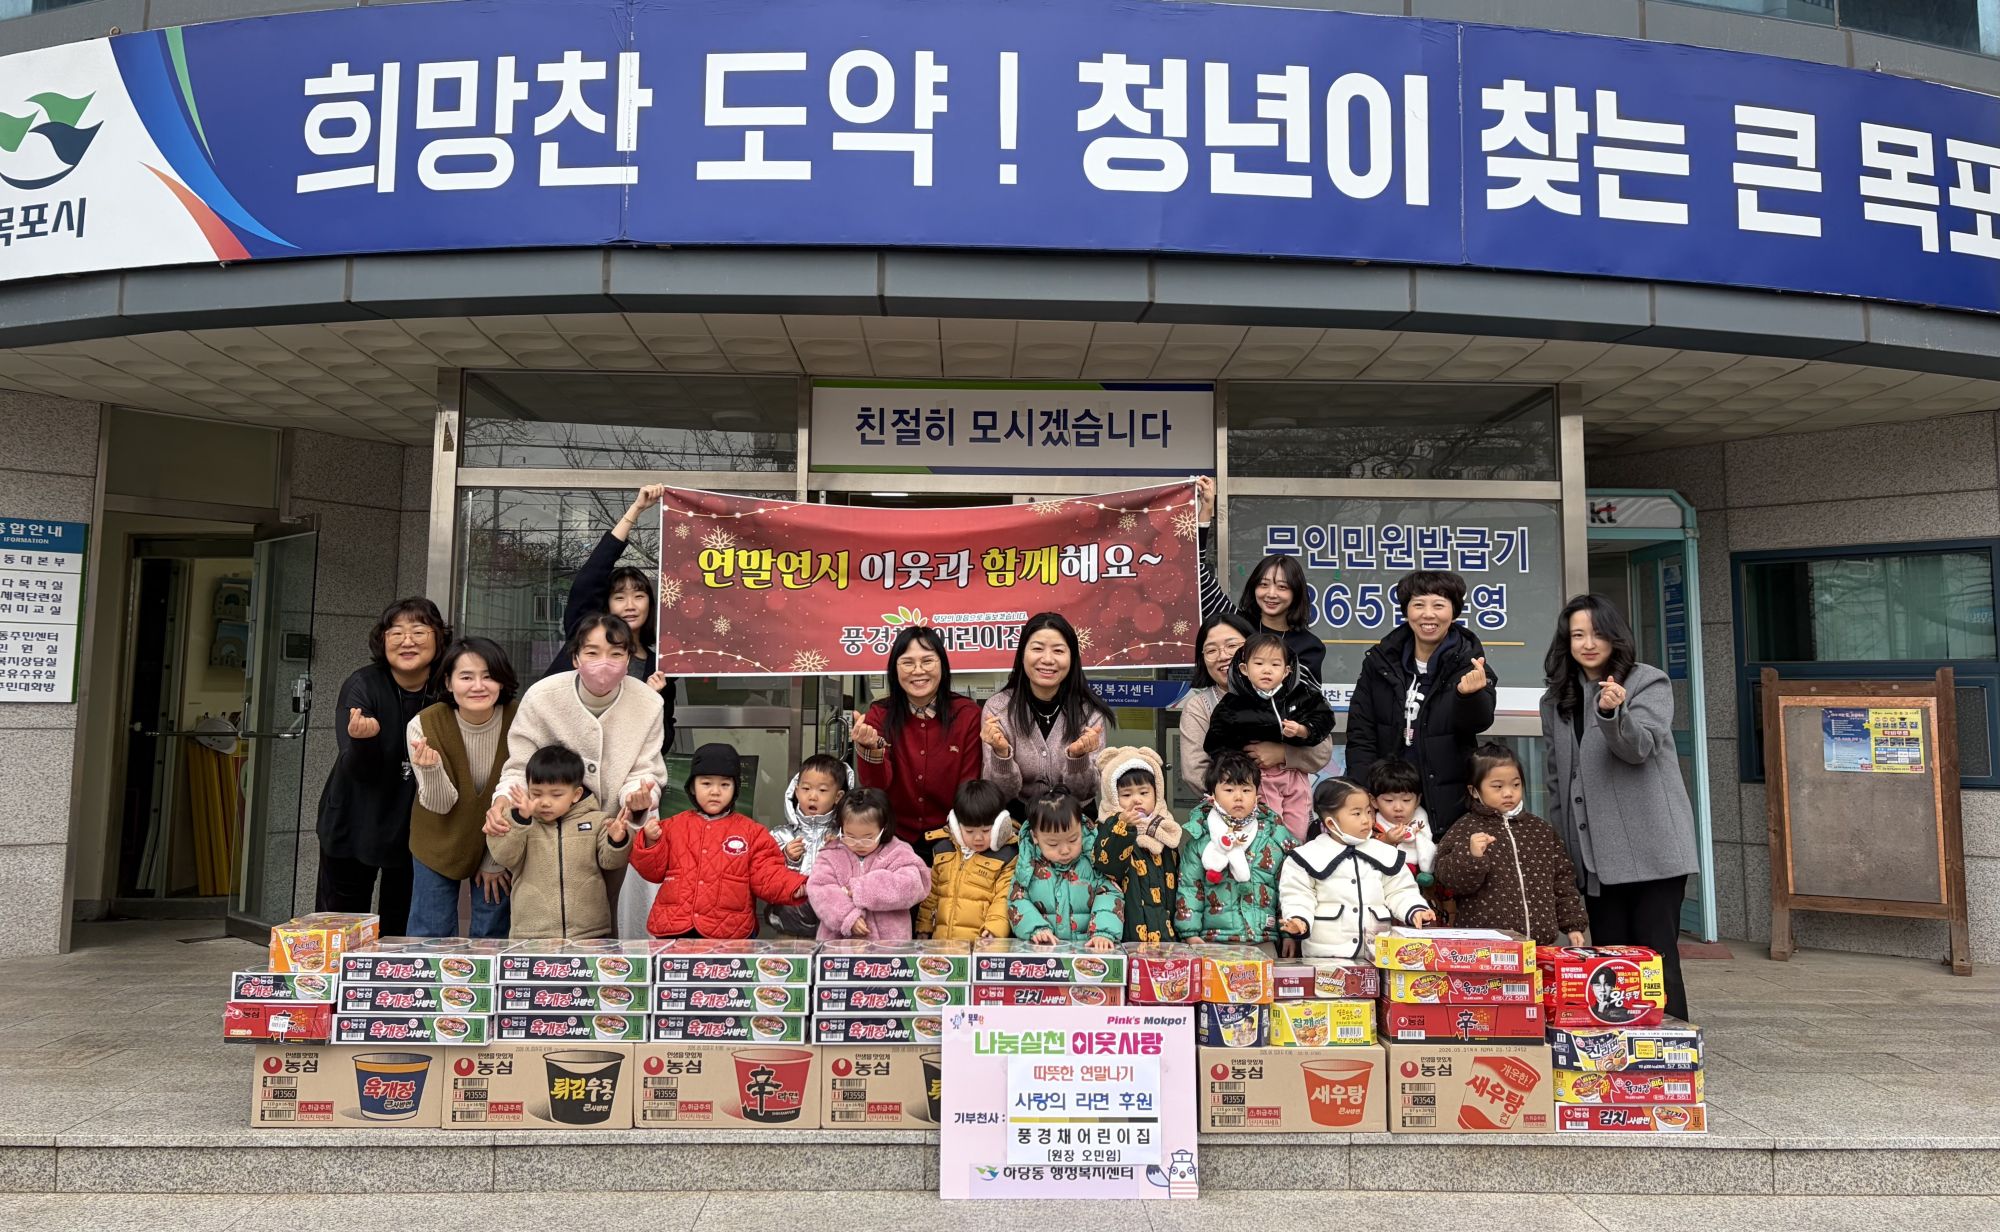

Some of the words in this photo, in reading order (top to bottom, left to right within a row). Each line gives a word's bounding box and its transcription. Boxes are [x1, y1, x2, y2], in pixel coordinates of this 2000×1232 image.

[297, 51, 652, 193] 희망찬
[696, 50, 947, 186] 도약
[1000, 52, 1018, 184] !
[1077, 53, 1429, 206] 청년이
[1481, 79, 1689, 224] 찾는
[1733, 105, 1822, 237] 큰
[856, 407, 954, 447] 친절히
[969, 408, 1171, 449] 모시겠습니다
[1590, 502, 1616, 523] kt
[1264, 524, 1529, 573] 무인민원발급기
[697, 546, 849, 590] 연말연시
[860, 549, 974, 588] 이웃과
[981, 543, 1163, 587] 함께해요~
[1088, 684, 1154, 696] 정복지센터
[376, 961, 414, 979] 육개장
[533, 960, 571, 977] 육개장
[693, 962, 731, 979] 육개장
[853, 961, 891, 978] 육개장
[1009, 961, 1047, 978] 육개장
[241, 983, 273, 997] 육개장
[534, 990, 572, 1007] 육개장
[1014, 989, 1044, 1004] 김치
[376, 991, 415, 1008] 육개장
[690, 991, 728, 1008] 육개장
[851, 991, 889, 1008] 육개장
[370, 1021, 408, 1038] 육개장
[531, 1019, 567, 1036] 육개장
[688, 1020, 725, 1037] 육개장
[1107, 1016, 1141, 1025] Pink's
[1143, 1016, 1187, 1026] Mokpo!
[849, 1022, 887, 1039] 육개장
[974, 1031, 1065, 1055] 나눔실천
[1072, 1031, 1163, 1055] 이웃사랑
[285, 1060, 318, 1073] 농심
[478, 1061, 512, 1075] 농심
[667, 1060, 701, 1074] 농심
[855, 1061, 890, 1076] 농심
[1034, 1065, 1074, 1081] 따뜻한
[1081, 1065, 1133, 1082] 연말나기
[1231, 1067, 1263, 1079] 농심
[1421, 1064, 1452, 1077] 농심
[1500, 1063, 1533, 1088] 개운한!
[364, 1077, 415, 1100] 육개장
[551, 1077, 614, 1102] 튀김우동
[747, 1065, 783, 1116] 辛
[1310, 1084, 1365, 1105] 새우탕
[1465, 1075, 1525, 1115] 새우탕
[1015, 1092, 1066, 1111] 사랑의
[1076, 1092, 1109, 1110] 라면
[1119, 1092, 1152, 1111] 후원
[1599, 1110, 1628, 1125] 김치
[1003, 1167, 1044, 1180] 하당동
[1050, 1167, 1133, 1180] 행정복지센터
